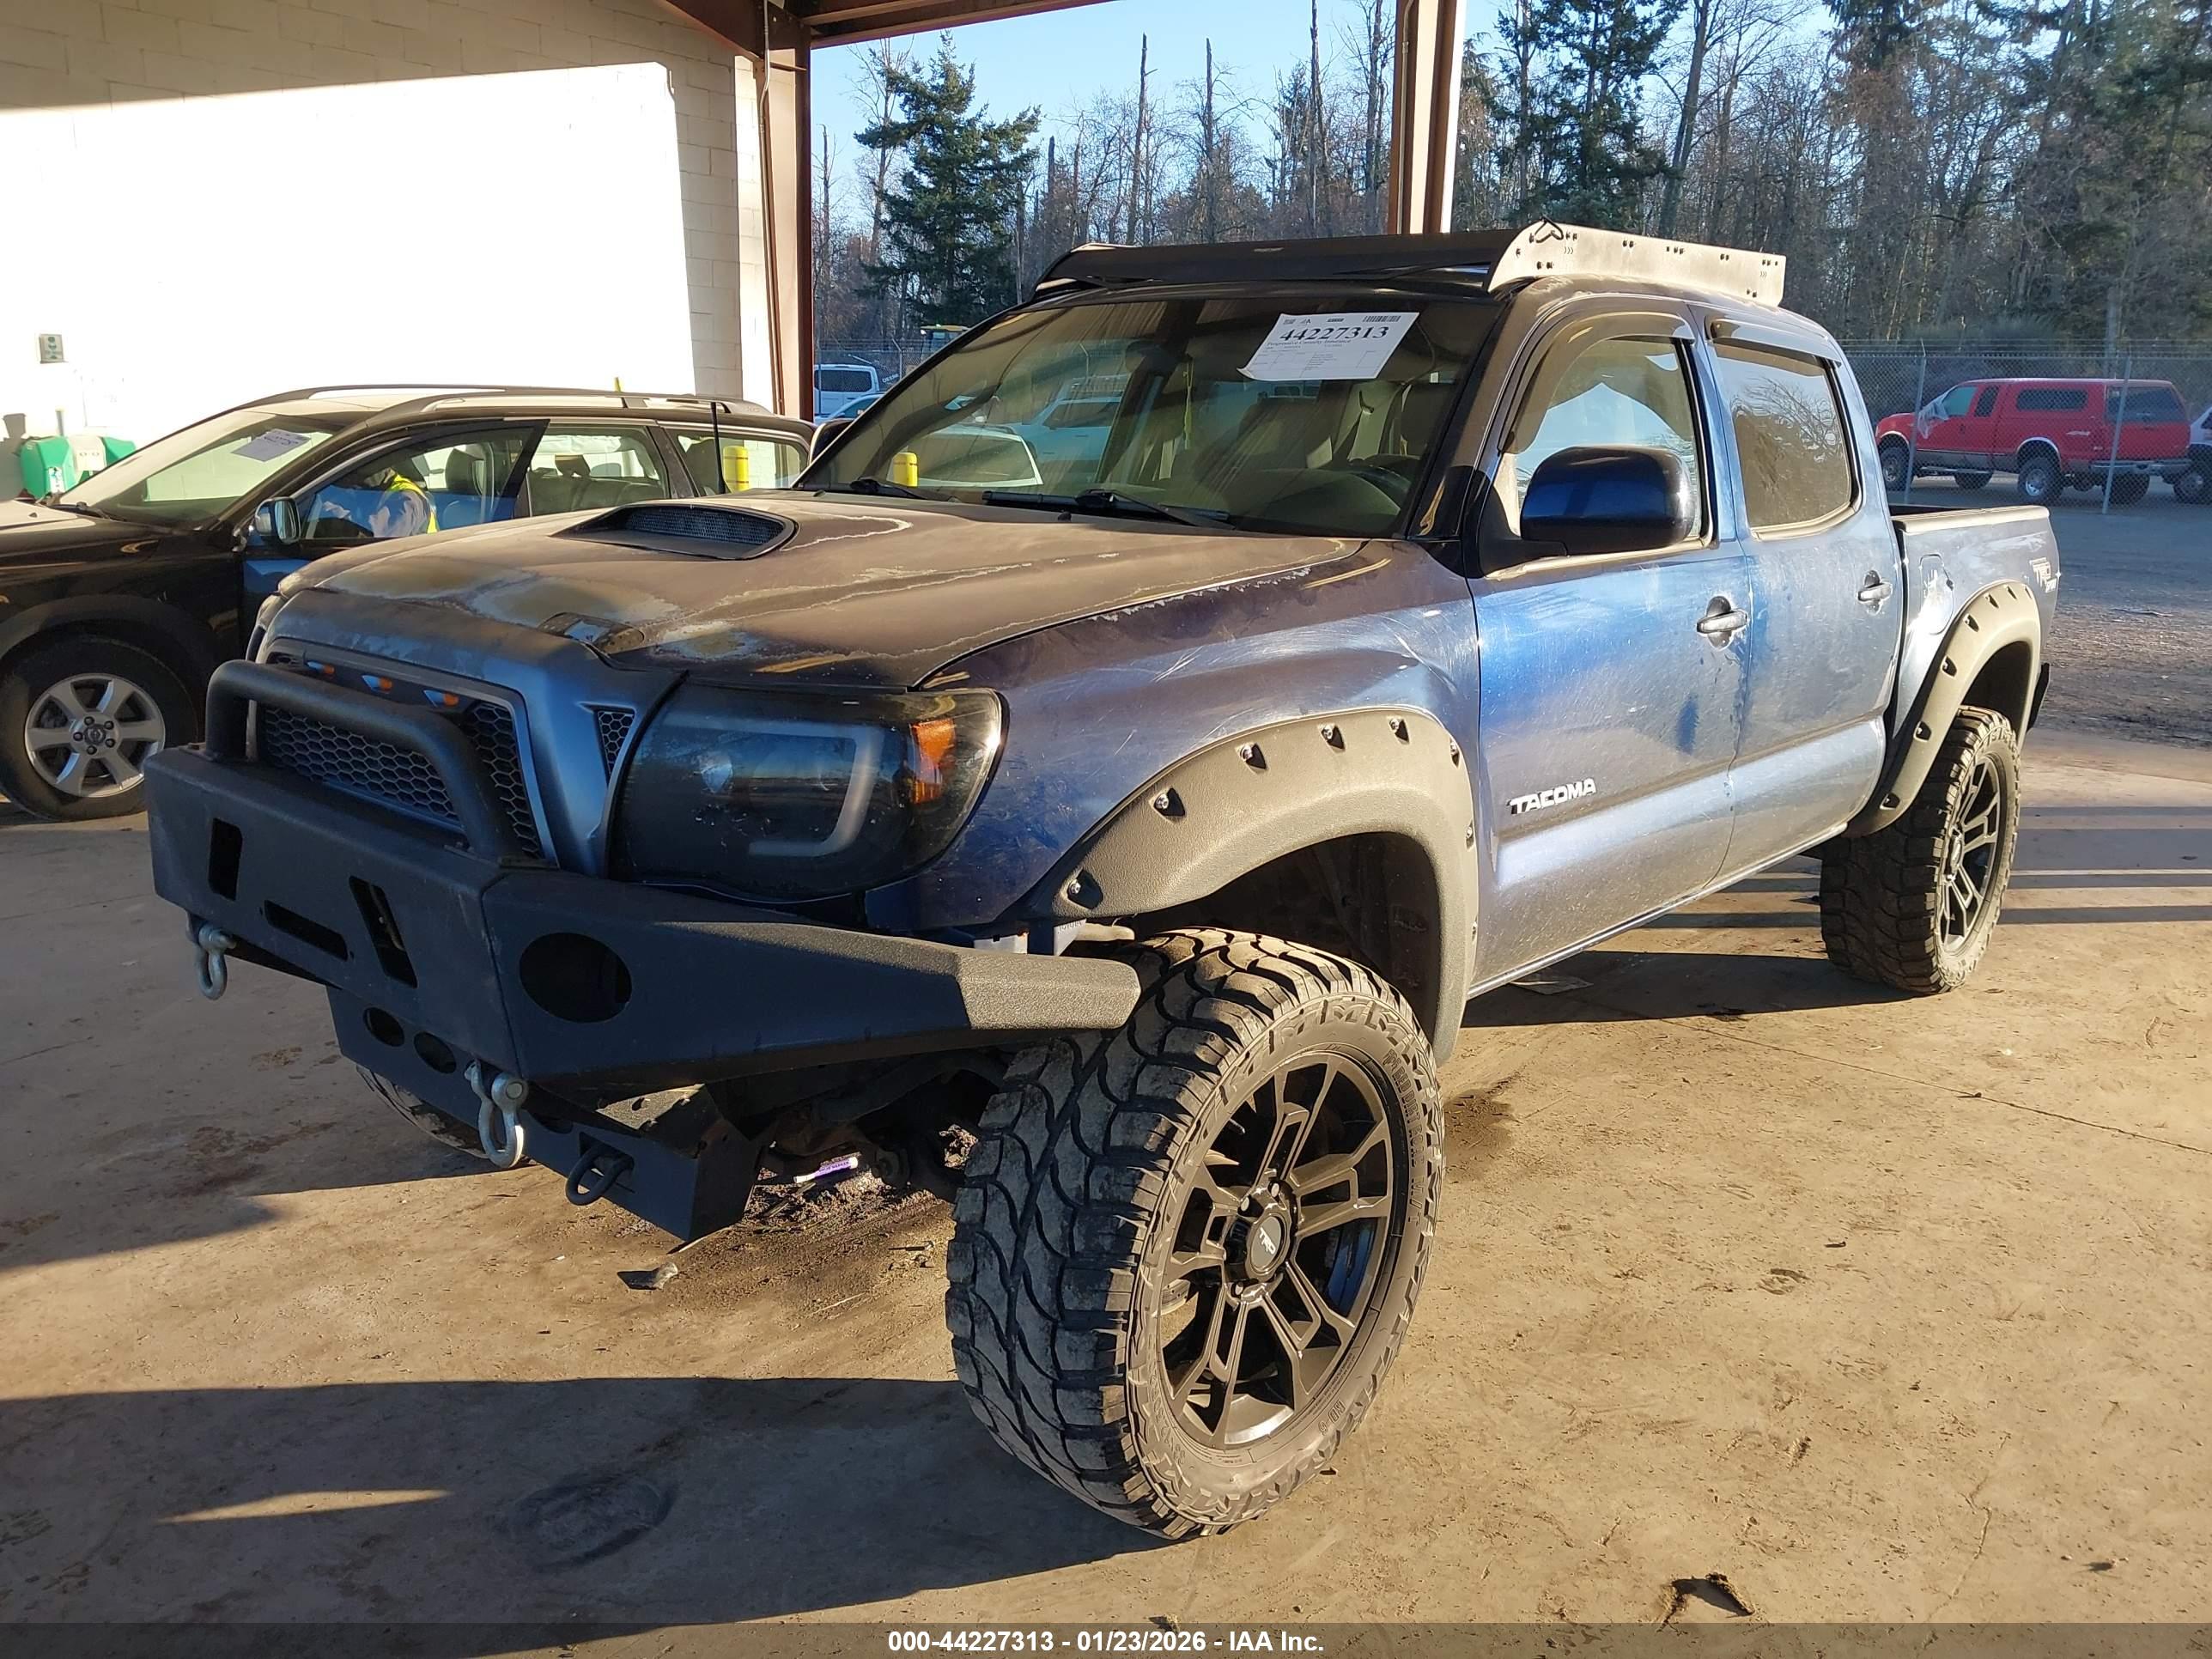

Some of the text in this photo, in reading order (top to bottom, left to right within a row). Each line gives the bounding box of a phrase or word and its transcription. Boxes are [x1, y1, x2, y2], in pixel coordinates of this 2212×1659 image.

[1279, 326, 1389, 341] 44227313
[1508, 778, 1596, 814] TACOMA
[1401, 1091, 1420, 1123] DIRT
[1260, 1227, 1276, 1255] TRD
